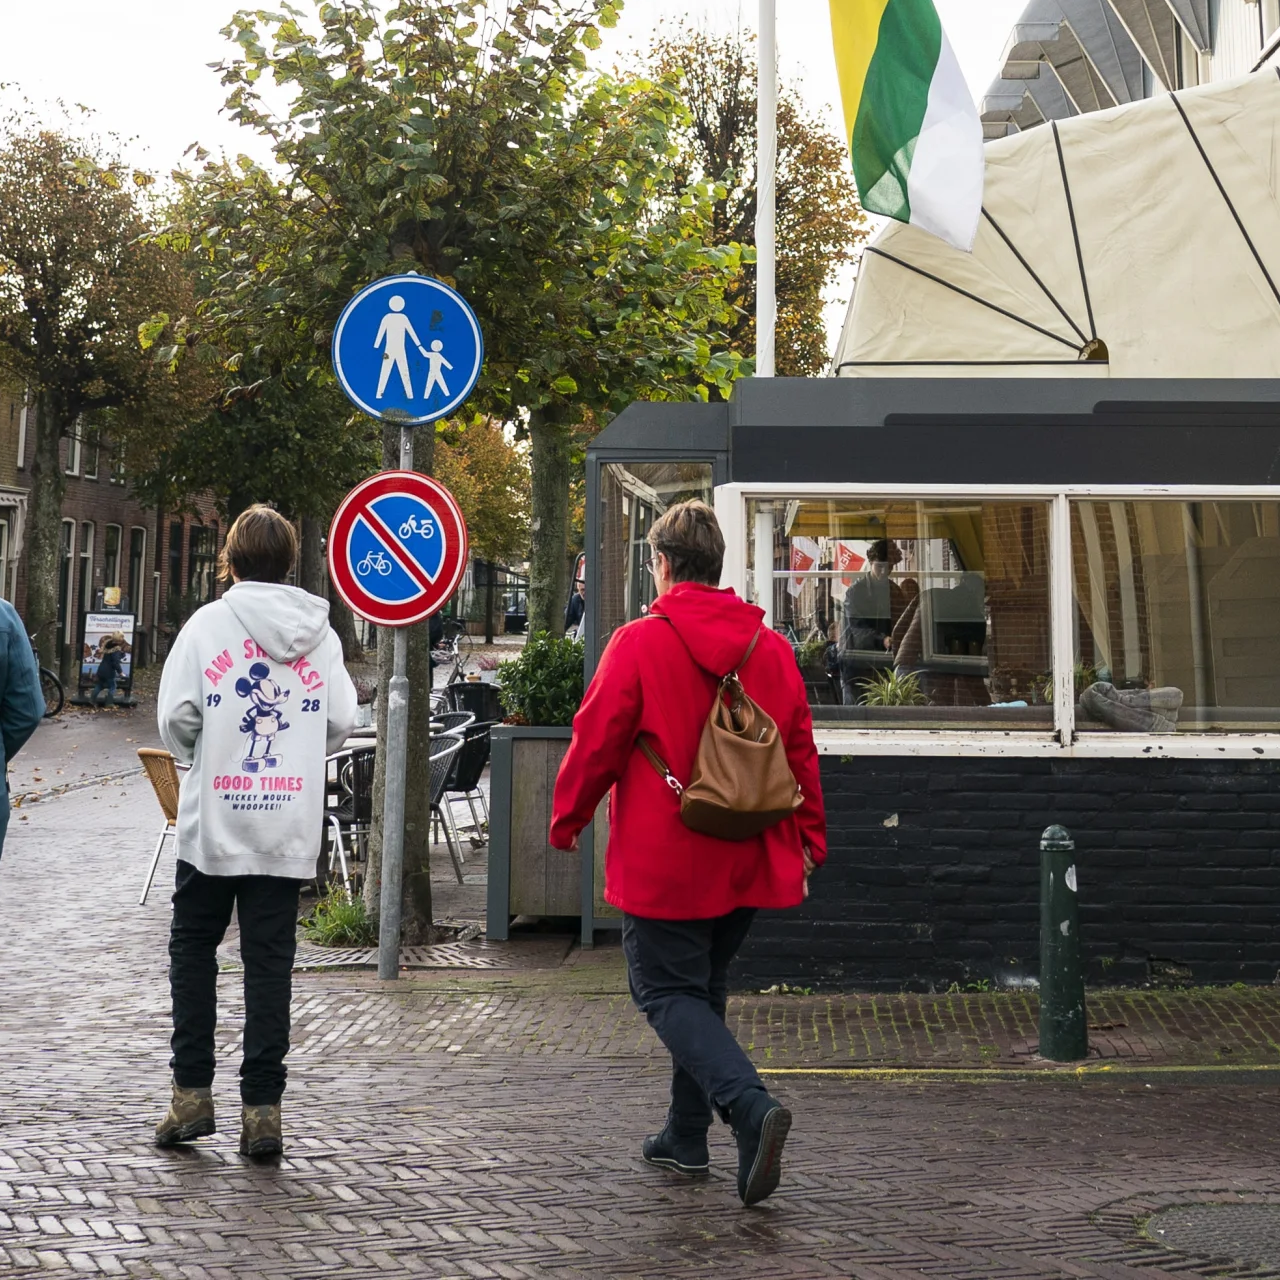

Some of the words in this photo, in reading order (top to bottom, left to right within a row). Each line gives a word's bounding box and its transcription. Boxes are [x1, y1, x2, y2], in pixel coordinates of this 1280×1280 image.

[204, 649, 234, 687] AW
[243, 639, 325, 693] SHKS!
[206, 693, 222, 708] 19
[301, 698, 321, 712] 28
[213, 775, 254, 791] GOOD
[260, 776, 304, 792] TIMES
[232, 803, 282, 811] WHOOPEE!!
